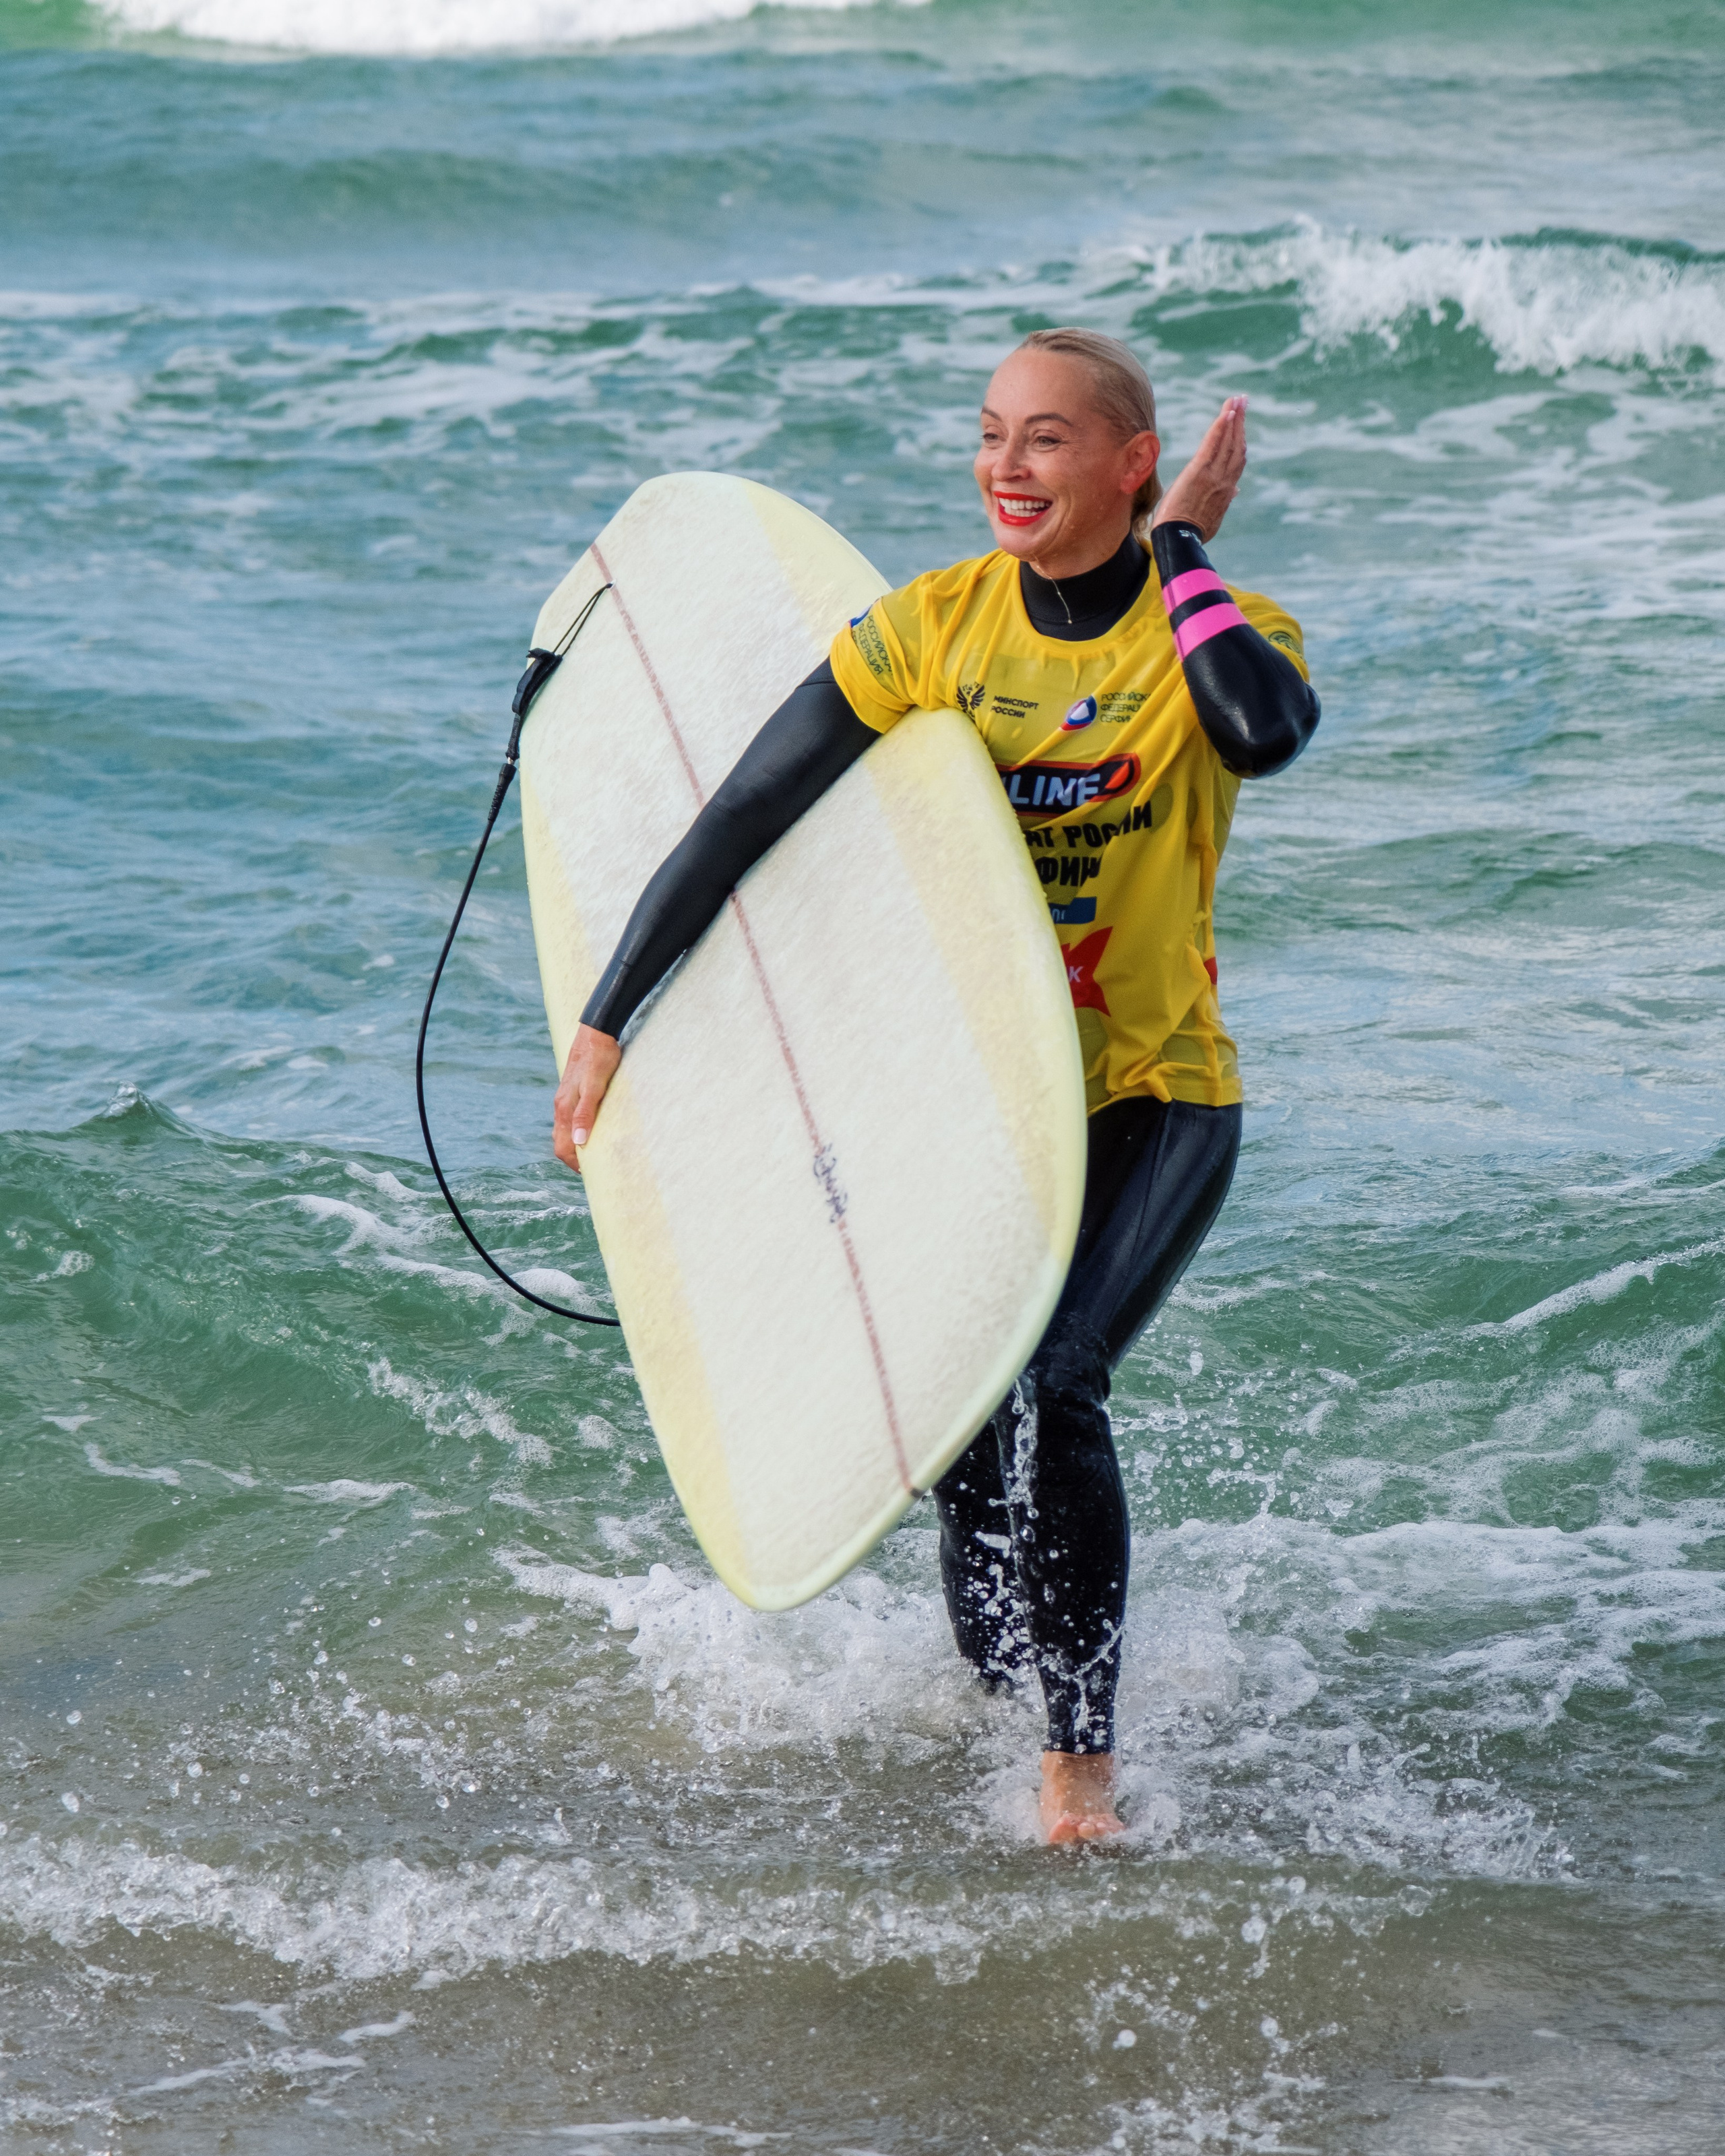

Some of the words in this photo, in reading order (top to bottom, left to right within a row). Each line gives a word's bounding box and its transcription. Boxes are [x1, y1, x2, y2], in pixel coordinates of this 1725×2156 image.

[867, 614, 893, 676] РОССИЙСКА
[991, 705, 1026, 719] РОССИИ
[993, 695, 1039, 710] МИНСПОРТ
[1002, 773, 1100, 806] LINE
